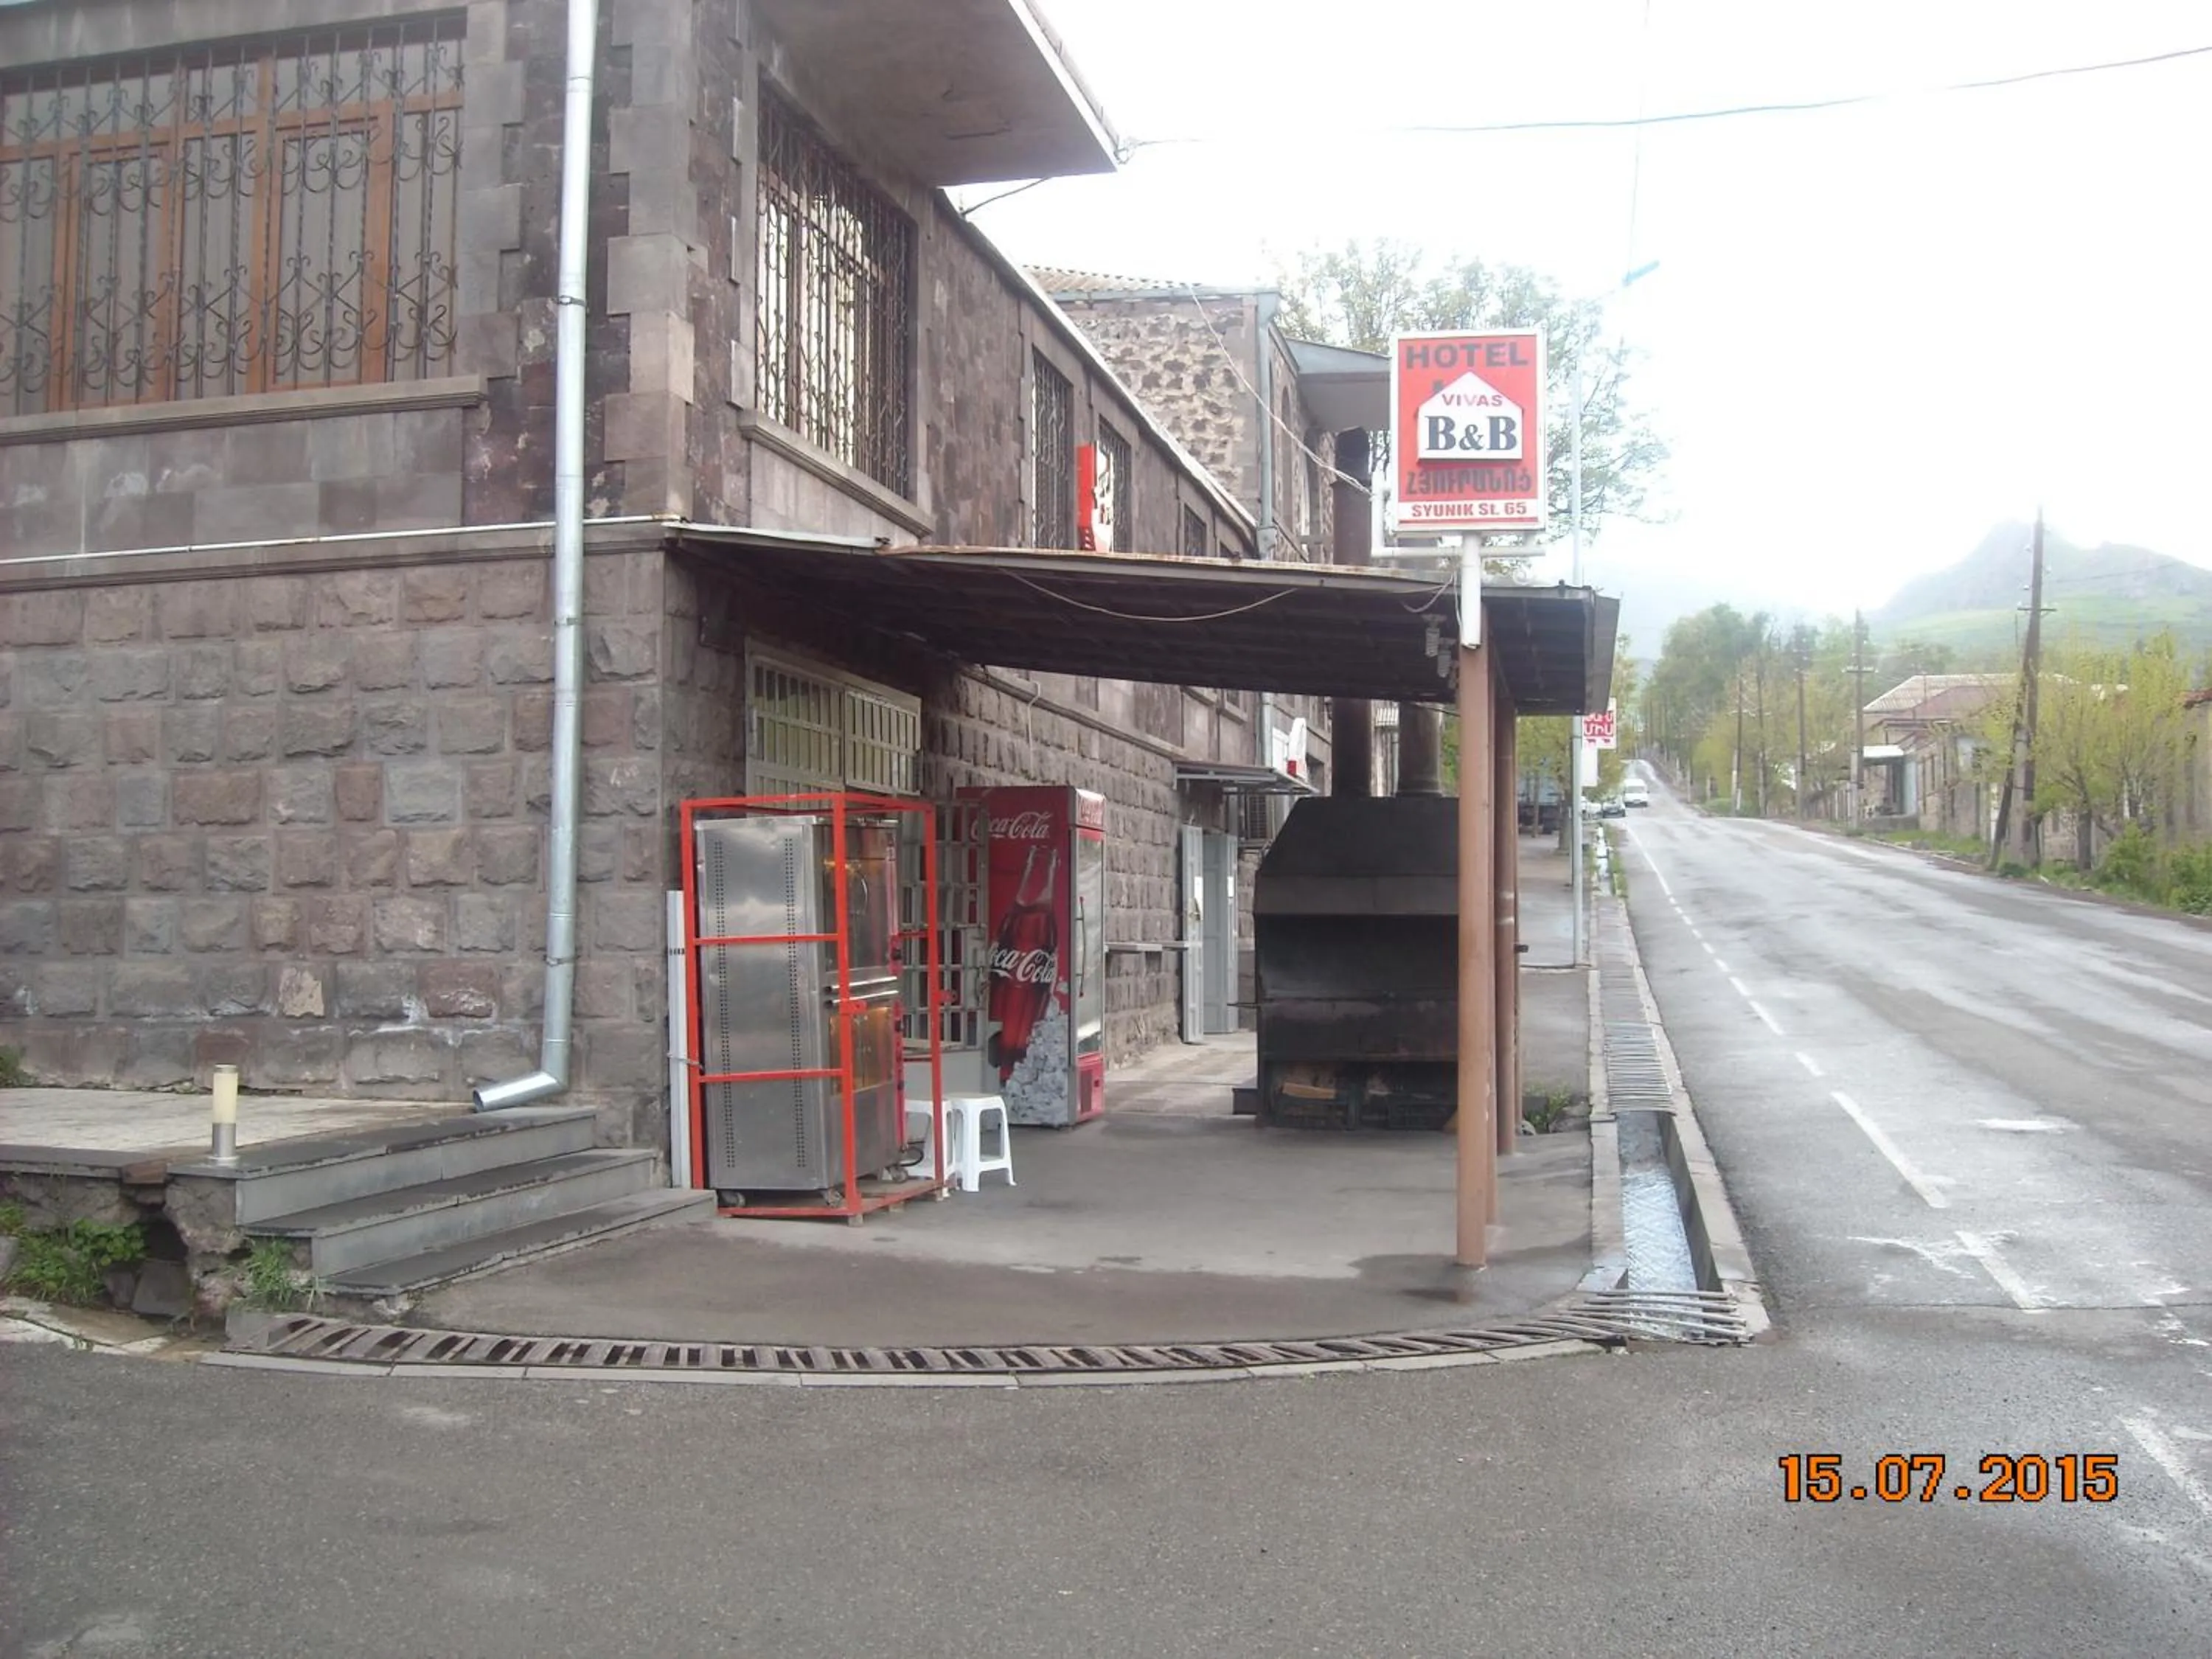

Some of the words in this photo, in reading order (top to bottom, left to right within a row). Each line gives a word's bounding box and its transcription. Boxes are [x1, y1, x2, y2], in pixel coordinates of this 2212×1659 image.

[1405, 341, 1528, 369] HOTEL
[1441, 393, 1503, 407] VIVAS
[1424, 415, 1517, 451] B&B
[1411, 503, 1474, 518] SYUNIK
[1504, 501, 1527, 515] 65
